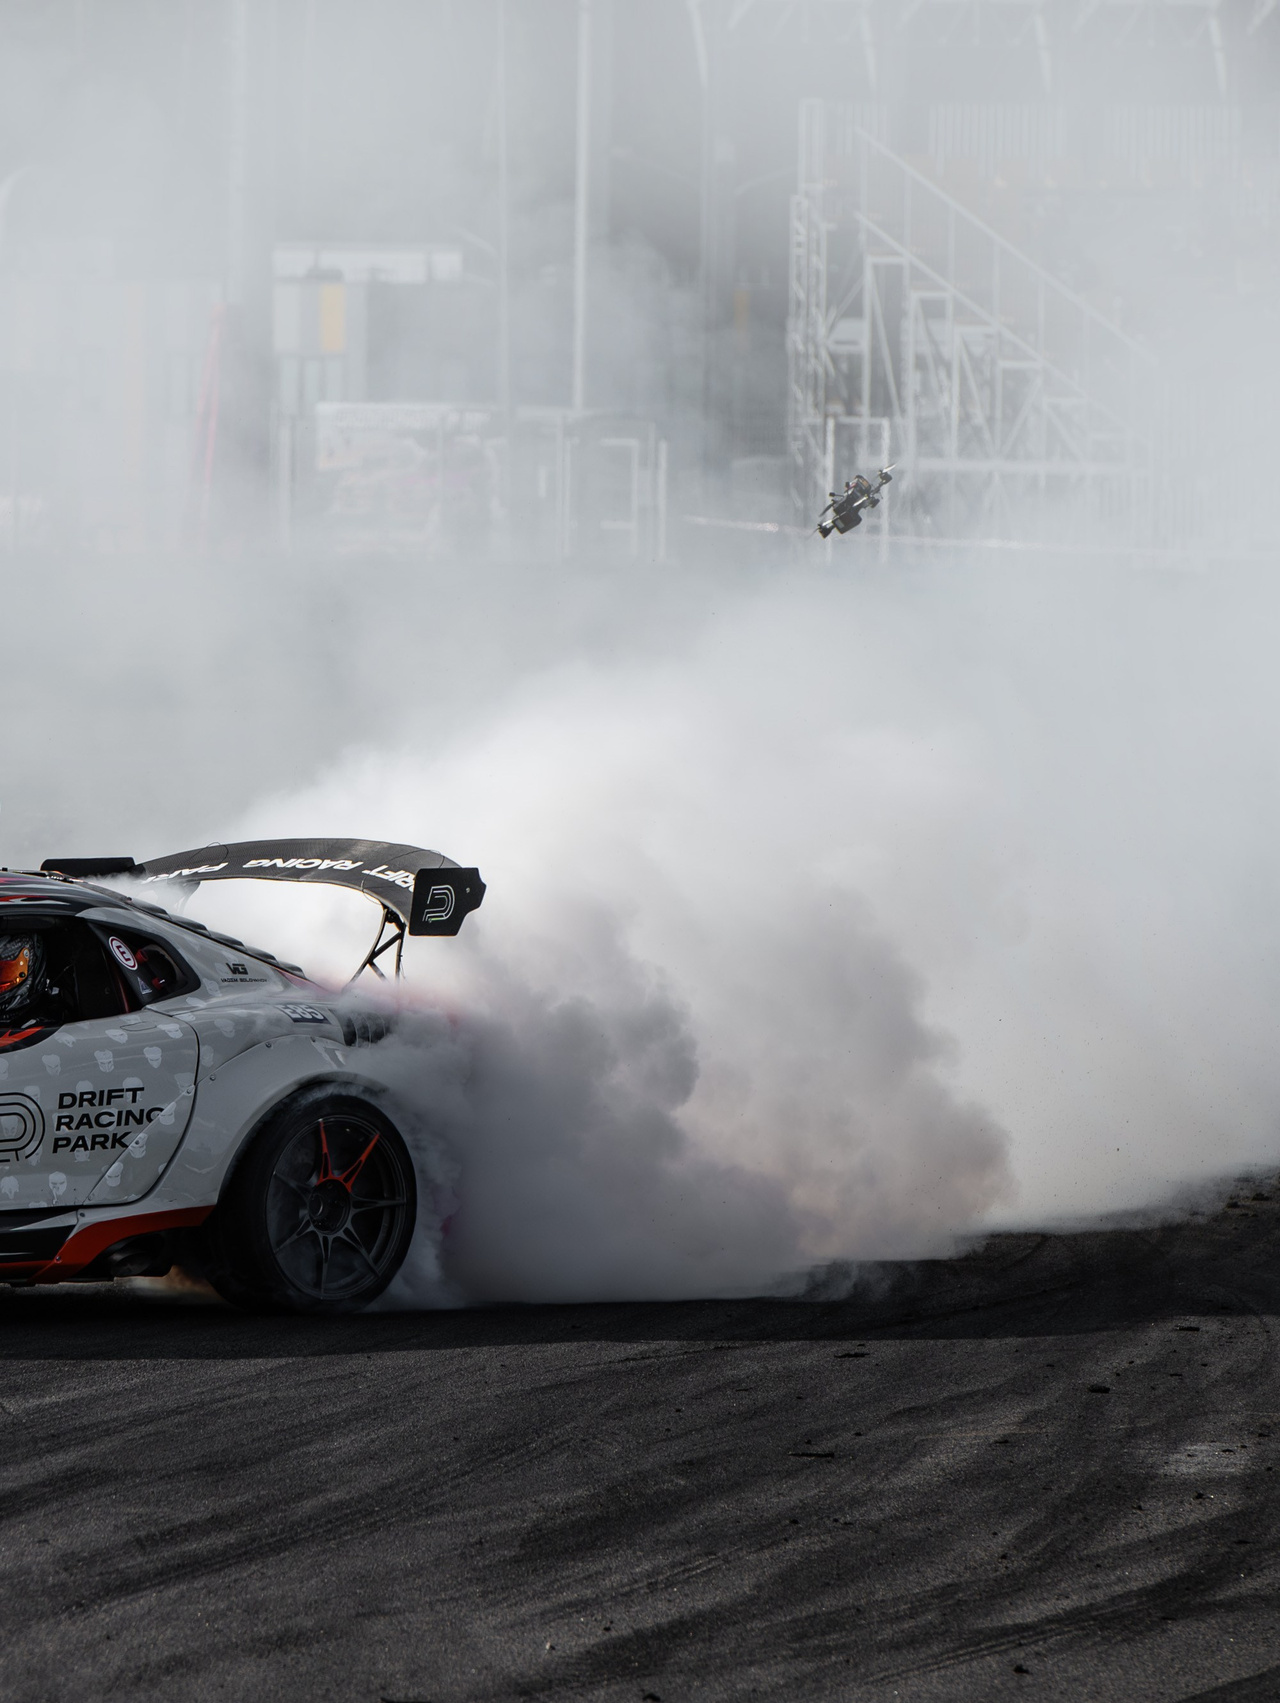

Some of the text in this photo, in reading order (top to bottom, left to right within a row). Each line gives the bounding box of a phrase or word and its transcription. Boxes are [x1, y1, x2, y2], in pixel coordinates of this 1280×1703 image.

[242, 857, 364, 871] RACING
[361, 864, 416, 893] RIFT
[58, 1086, 145, 1110] DRIFT
[52, 1131, 133, 1154] PARK
